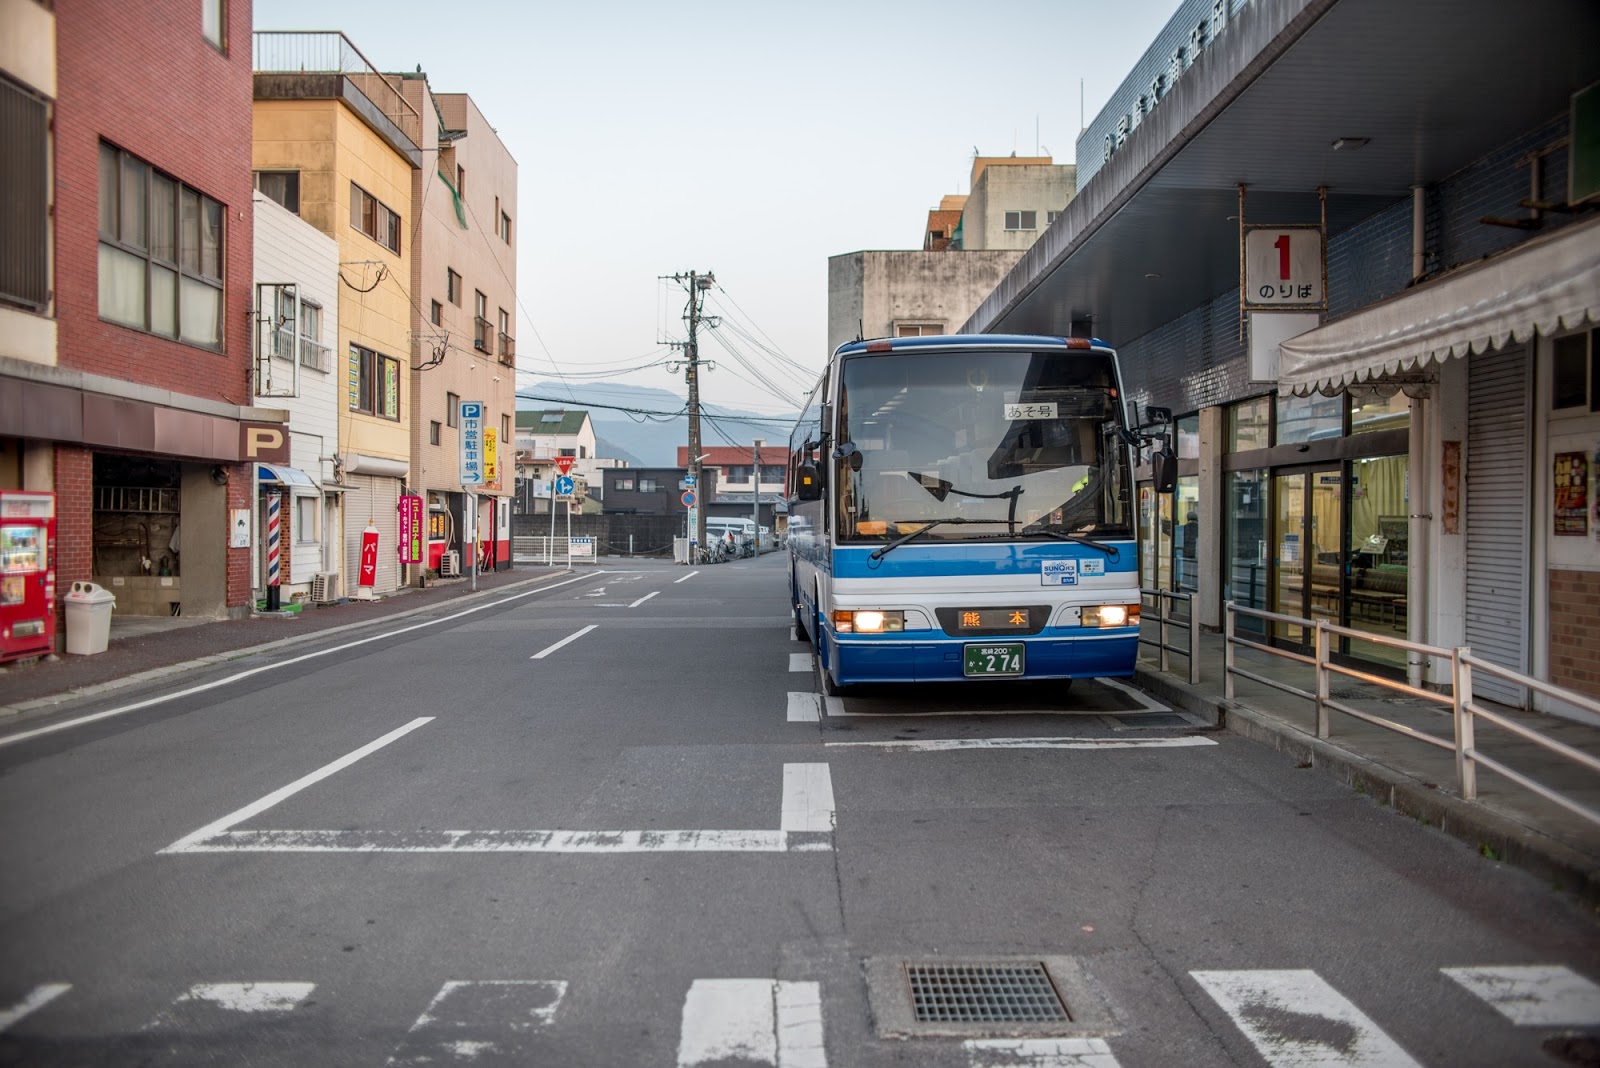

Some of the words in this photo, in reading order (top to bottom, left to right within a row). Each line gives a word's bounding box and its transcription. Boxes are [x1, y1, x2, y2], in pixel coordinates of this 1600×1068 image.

[1274, 235, 1291, 280] 1
[1259, 284, 1312, 299] のりば
[464, 405, 477, 417] P
[1008, 405, 1053, 418] あそ号
[247, 427, 283, 457] P
[464, 419, 478, 471] 市営駐車場
[363, 542, 376, 575] パーマ
